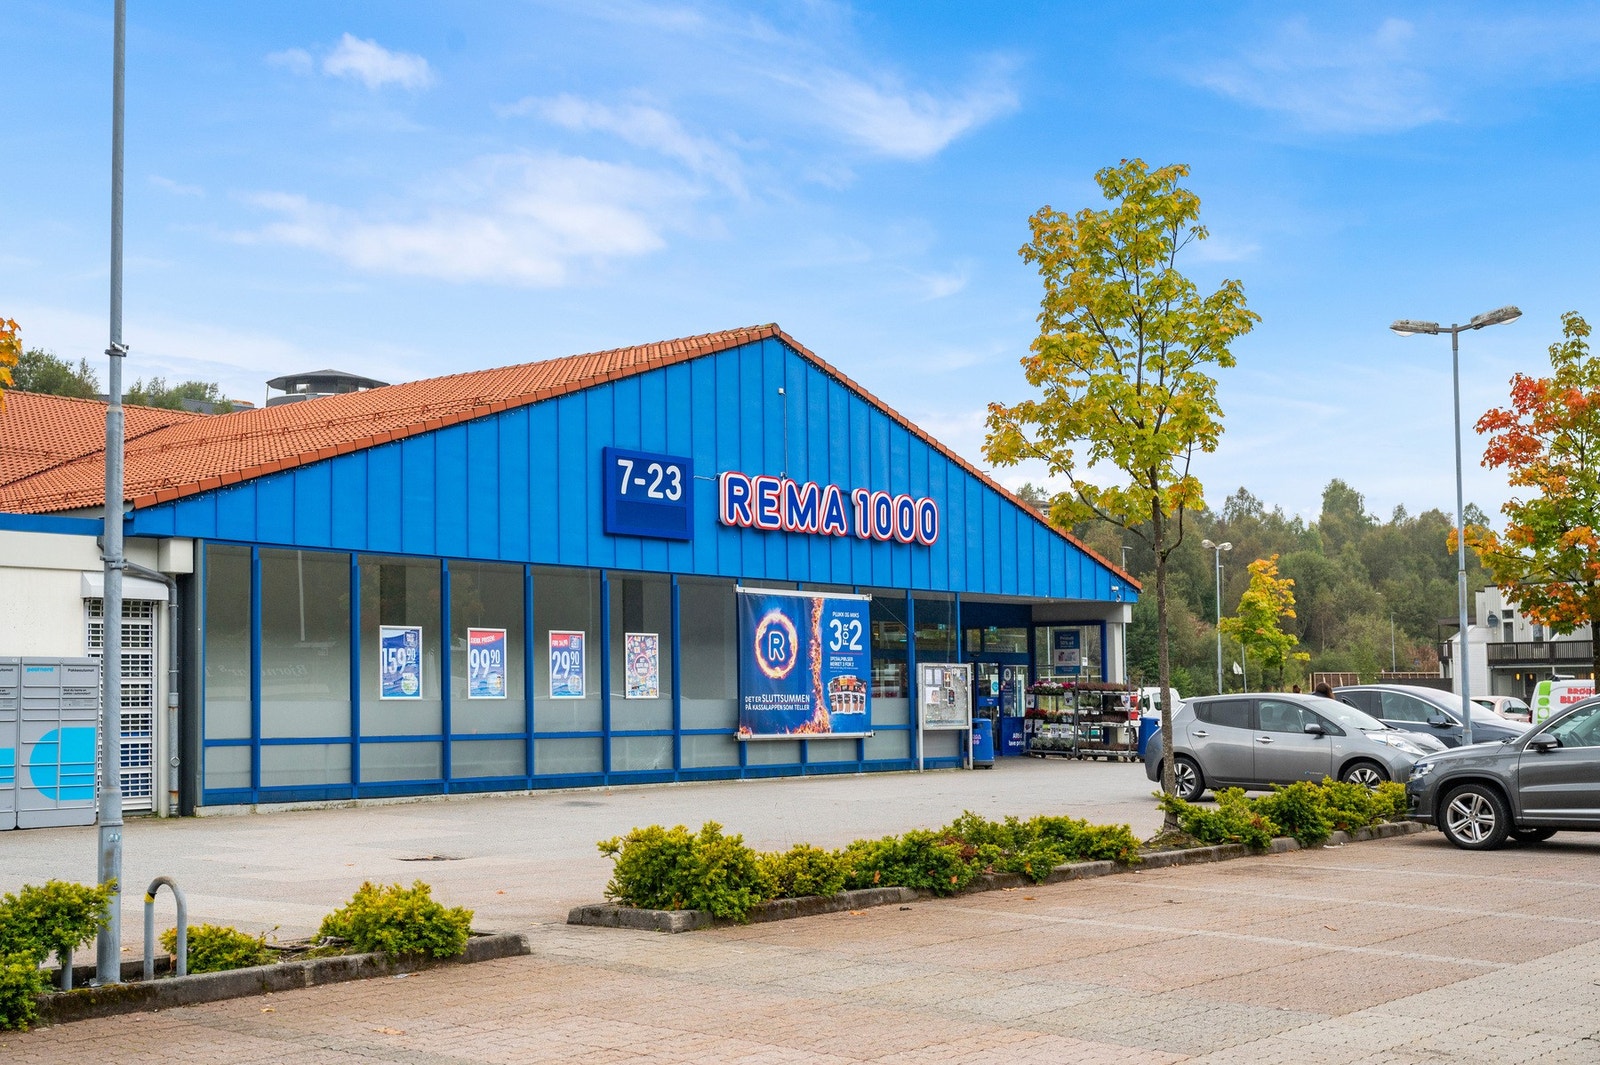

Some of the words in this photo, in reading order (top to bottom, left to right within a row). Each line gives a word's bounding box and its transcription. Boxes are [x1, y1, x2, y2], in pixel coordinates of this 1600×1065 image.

[618, 459, 682, 502] 7-23
[720, 471, 848, 538] REMA
[852, 487, 940, 547] 1000
[768, 630, 786, 661] R
[829, 619, 842, 651] 3
[849, 619, 862, 651] 2
[382, 648, 406, 674] 159
[407, 648, 416, 661] 90
[471, 649, 490, 678] 99
[491, 650, 500, 663] 90
[552, 651, 570, 679] 29
[570, 651, 580, 665] 90
[762, 694, 810, 703] SLUTTSUMMEN
